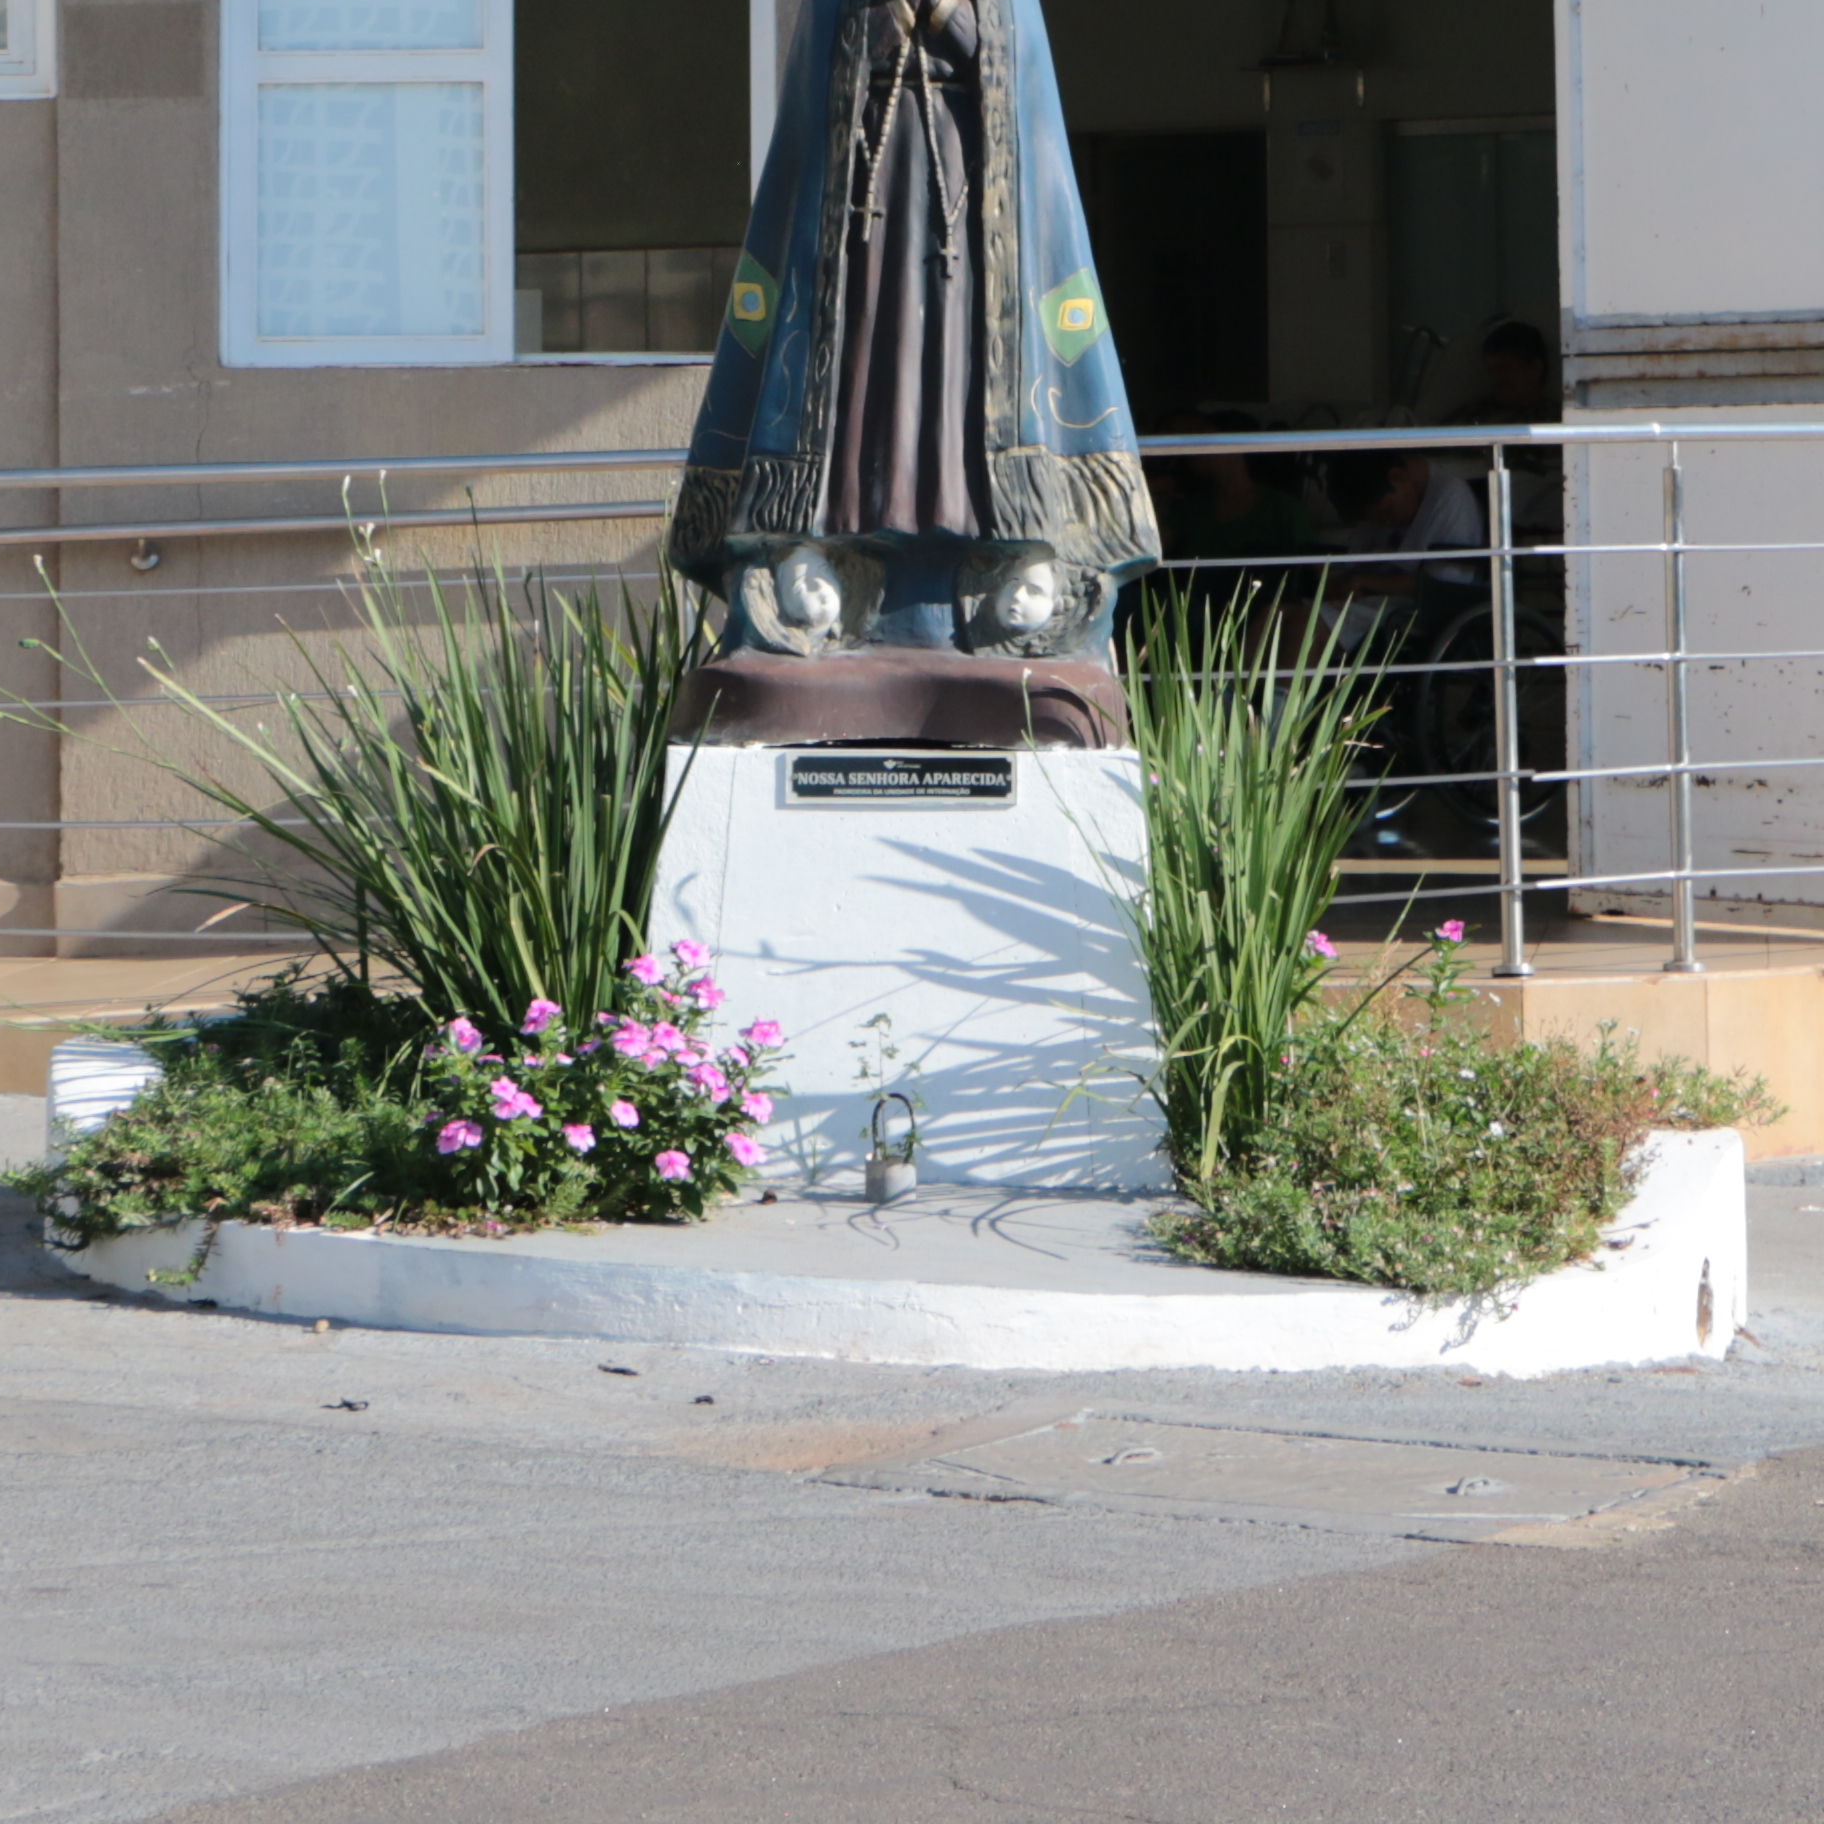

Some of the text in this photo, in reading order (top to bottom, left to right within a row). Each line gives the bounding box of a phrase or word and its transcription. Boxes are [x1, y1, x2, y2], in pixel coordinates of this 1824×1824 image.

[797, 772, 1007, 786] NOSSA SENHORA APARECIDA
[926, 787, 971, 796] INTERNAÇÃO
